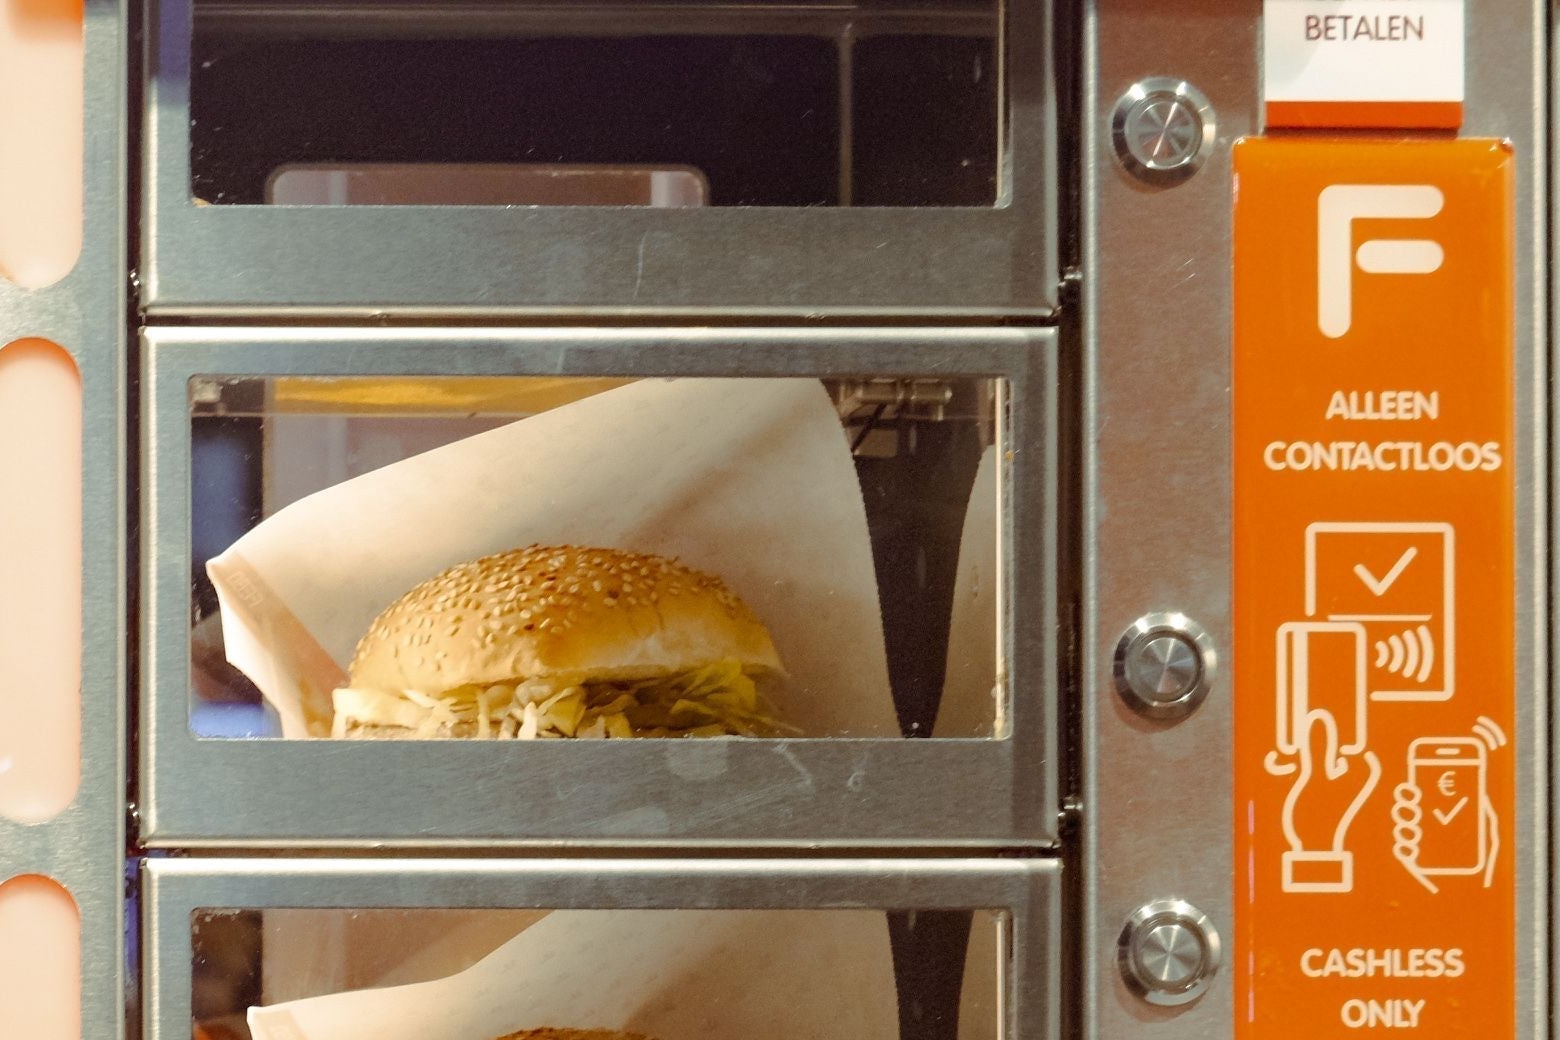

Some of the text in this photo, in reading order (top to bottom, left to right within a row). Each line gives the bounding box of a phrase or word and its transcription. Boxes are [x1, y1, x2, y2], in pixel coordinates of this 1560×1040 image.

[1304, 14, 1424, 41] BETALEN
[1317, 184, 1445, 339] F
[1325, 390, 1439, 421] ALLEEN
[1263, 440, 1503, 472] CONTACTLOOS
[1300, 947, 1466, 978] CASHLESS
[1340, 998, 1426, 1029] ONLY
